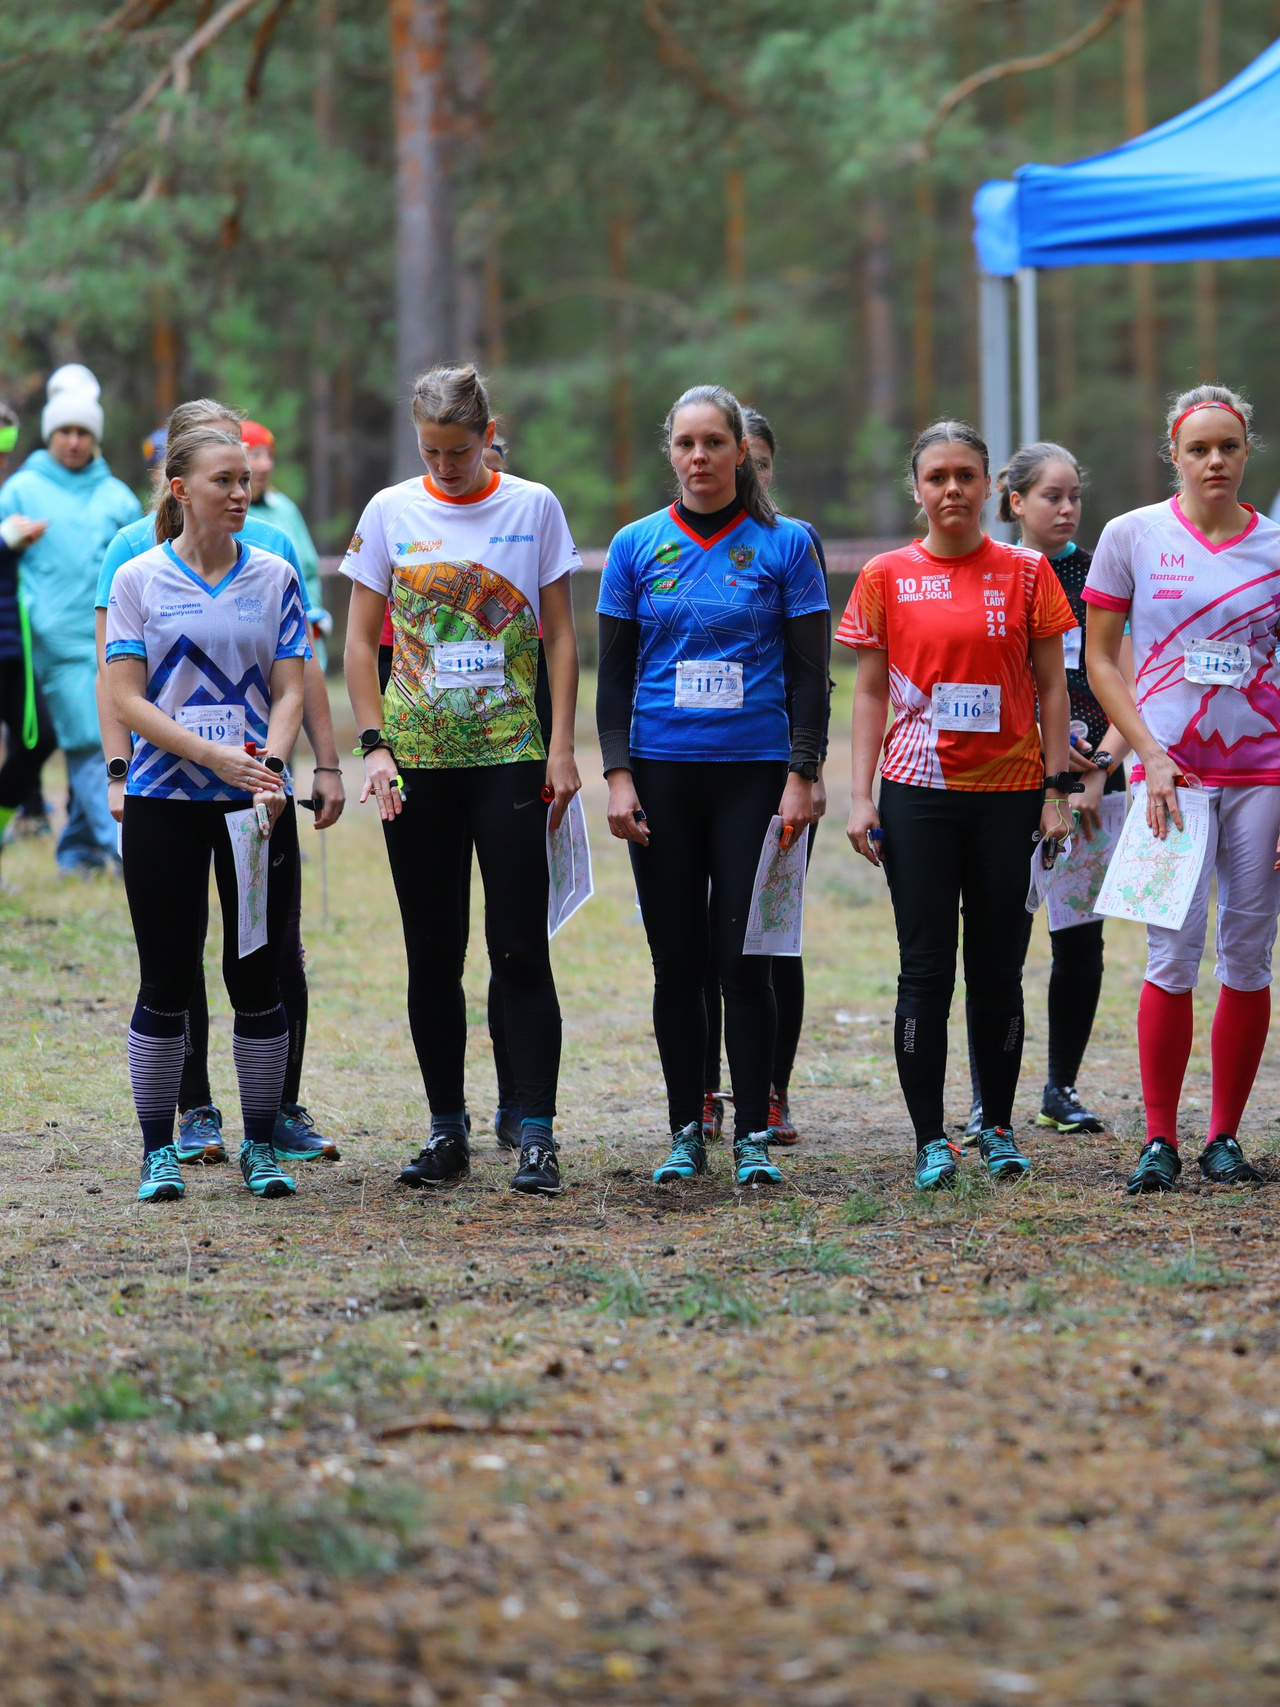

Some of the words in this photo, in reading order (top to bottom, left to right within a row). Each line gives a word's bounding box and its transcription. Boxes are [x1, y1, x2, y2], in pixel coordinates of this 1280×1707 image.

[896, 578, 916, 593] 10
[921, 579, 950, 592] лет
[897, 592, 924, 603] SIRIUS
[926, 590, 952, 599] SOCHI
[984, 597, 1005, 606] LADY
[457, 657, 484, 672] 118
[1206, 657, 1231, 673] 115
[697, 678, 724, 693] 117
[954, 702, 980, 717] 116
[197, 725, 225, 740] 119
